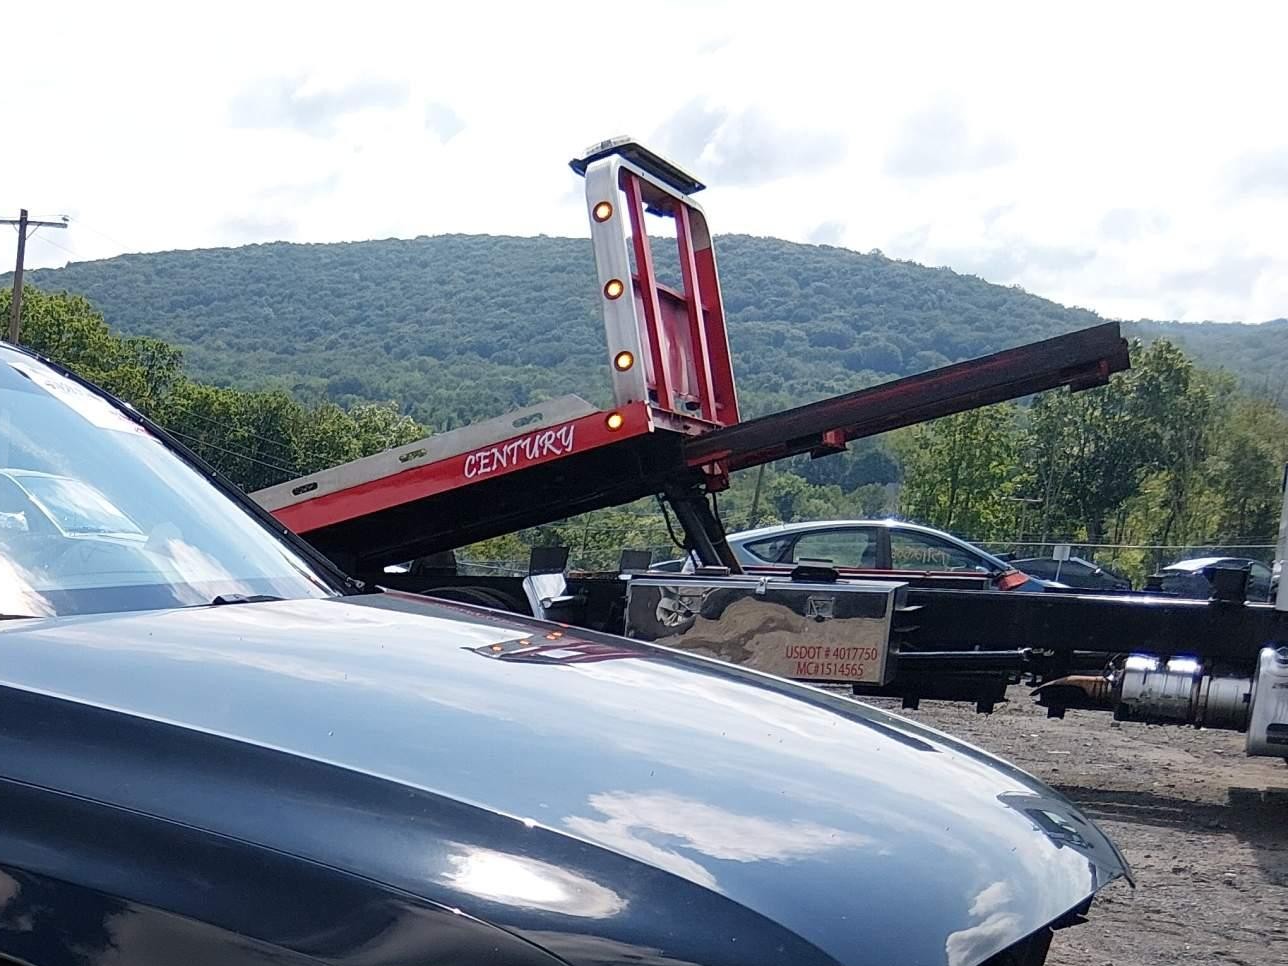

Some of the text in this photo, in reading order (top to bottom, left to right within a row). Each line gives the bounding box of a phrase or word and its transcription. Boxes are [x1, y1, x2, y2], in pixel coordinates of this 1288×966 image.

[464, 424, 575, 478] CENTURY
[785, 645, 822, 659] USDOT
[832, 647, 878, 661] 4017750
[796, 661, 864, 677] MC#1514565
